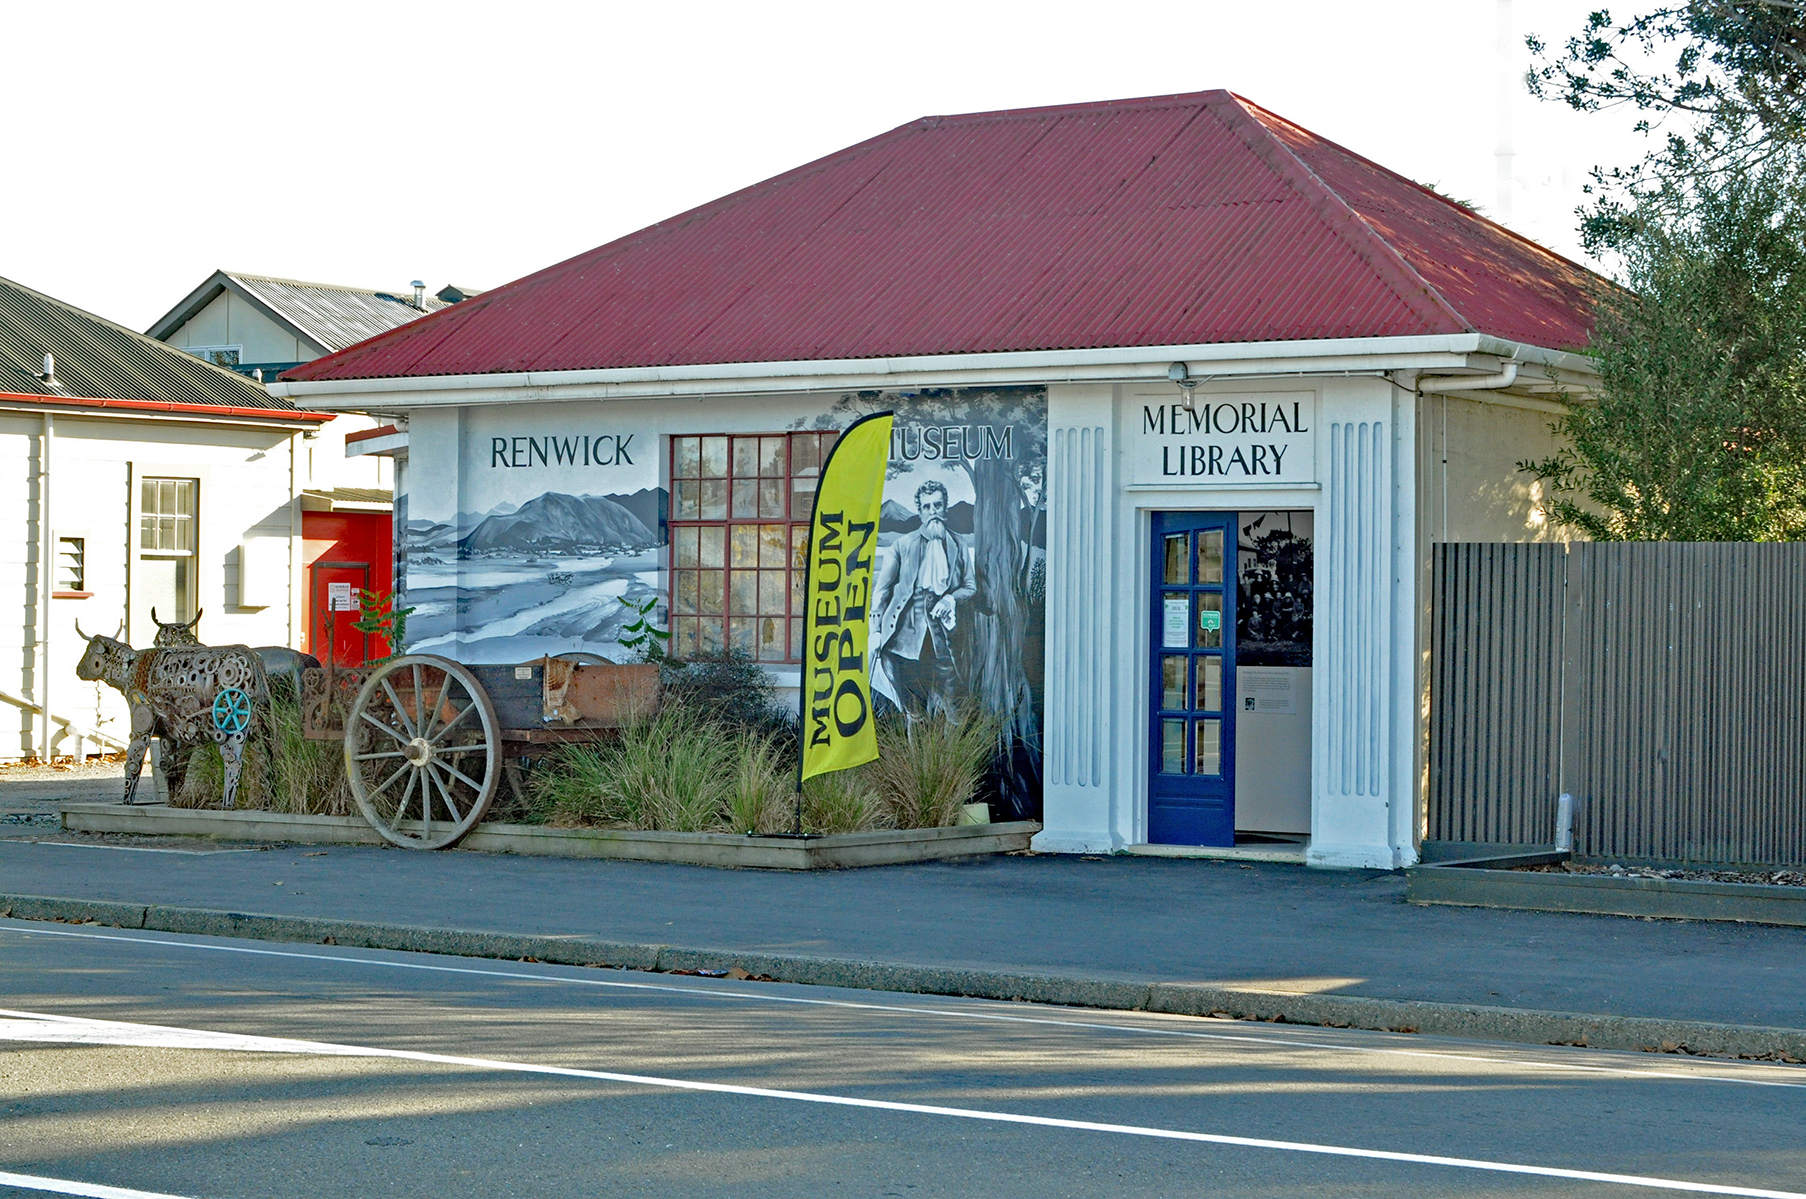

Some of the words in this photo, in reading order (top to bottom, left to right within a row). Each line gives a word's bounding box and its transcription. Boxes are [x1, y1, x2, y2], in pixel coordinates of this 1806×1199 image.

[1143, 402, 1308, 434] MEMORIAL
[491, 434, 634, 467] RENWICK
[1163, 444, 1288, 476] LIBRARY
[810, 511, 844, 748] MUSEUM
[833, 520, 875, 738] OPEN
